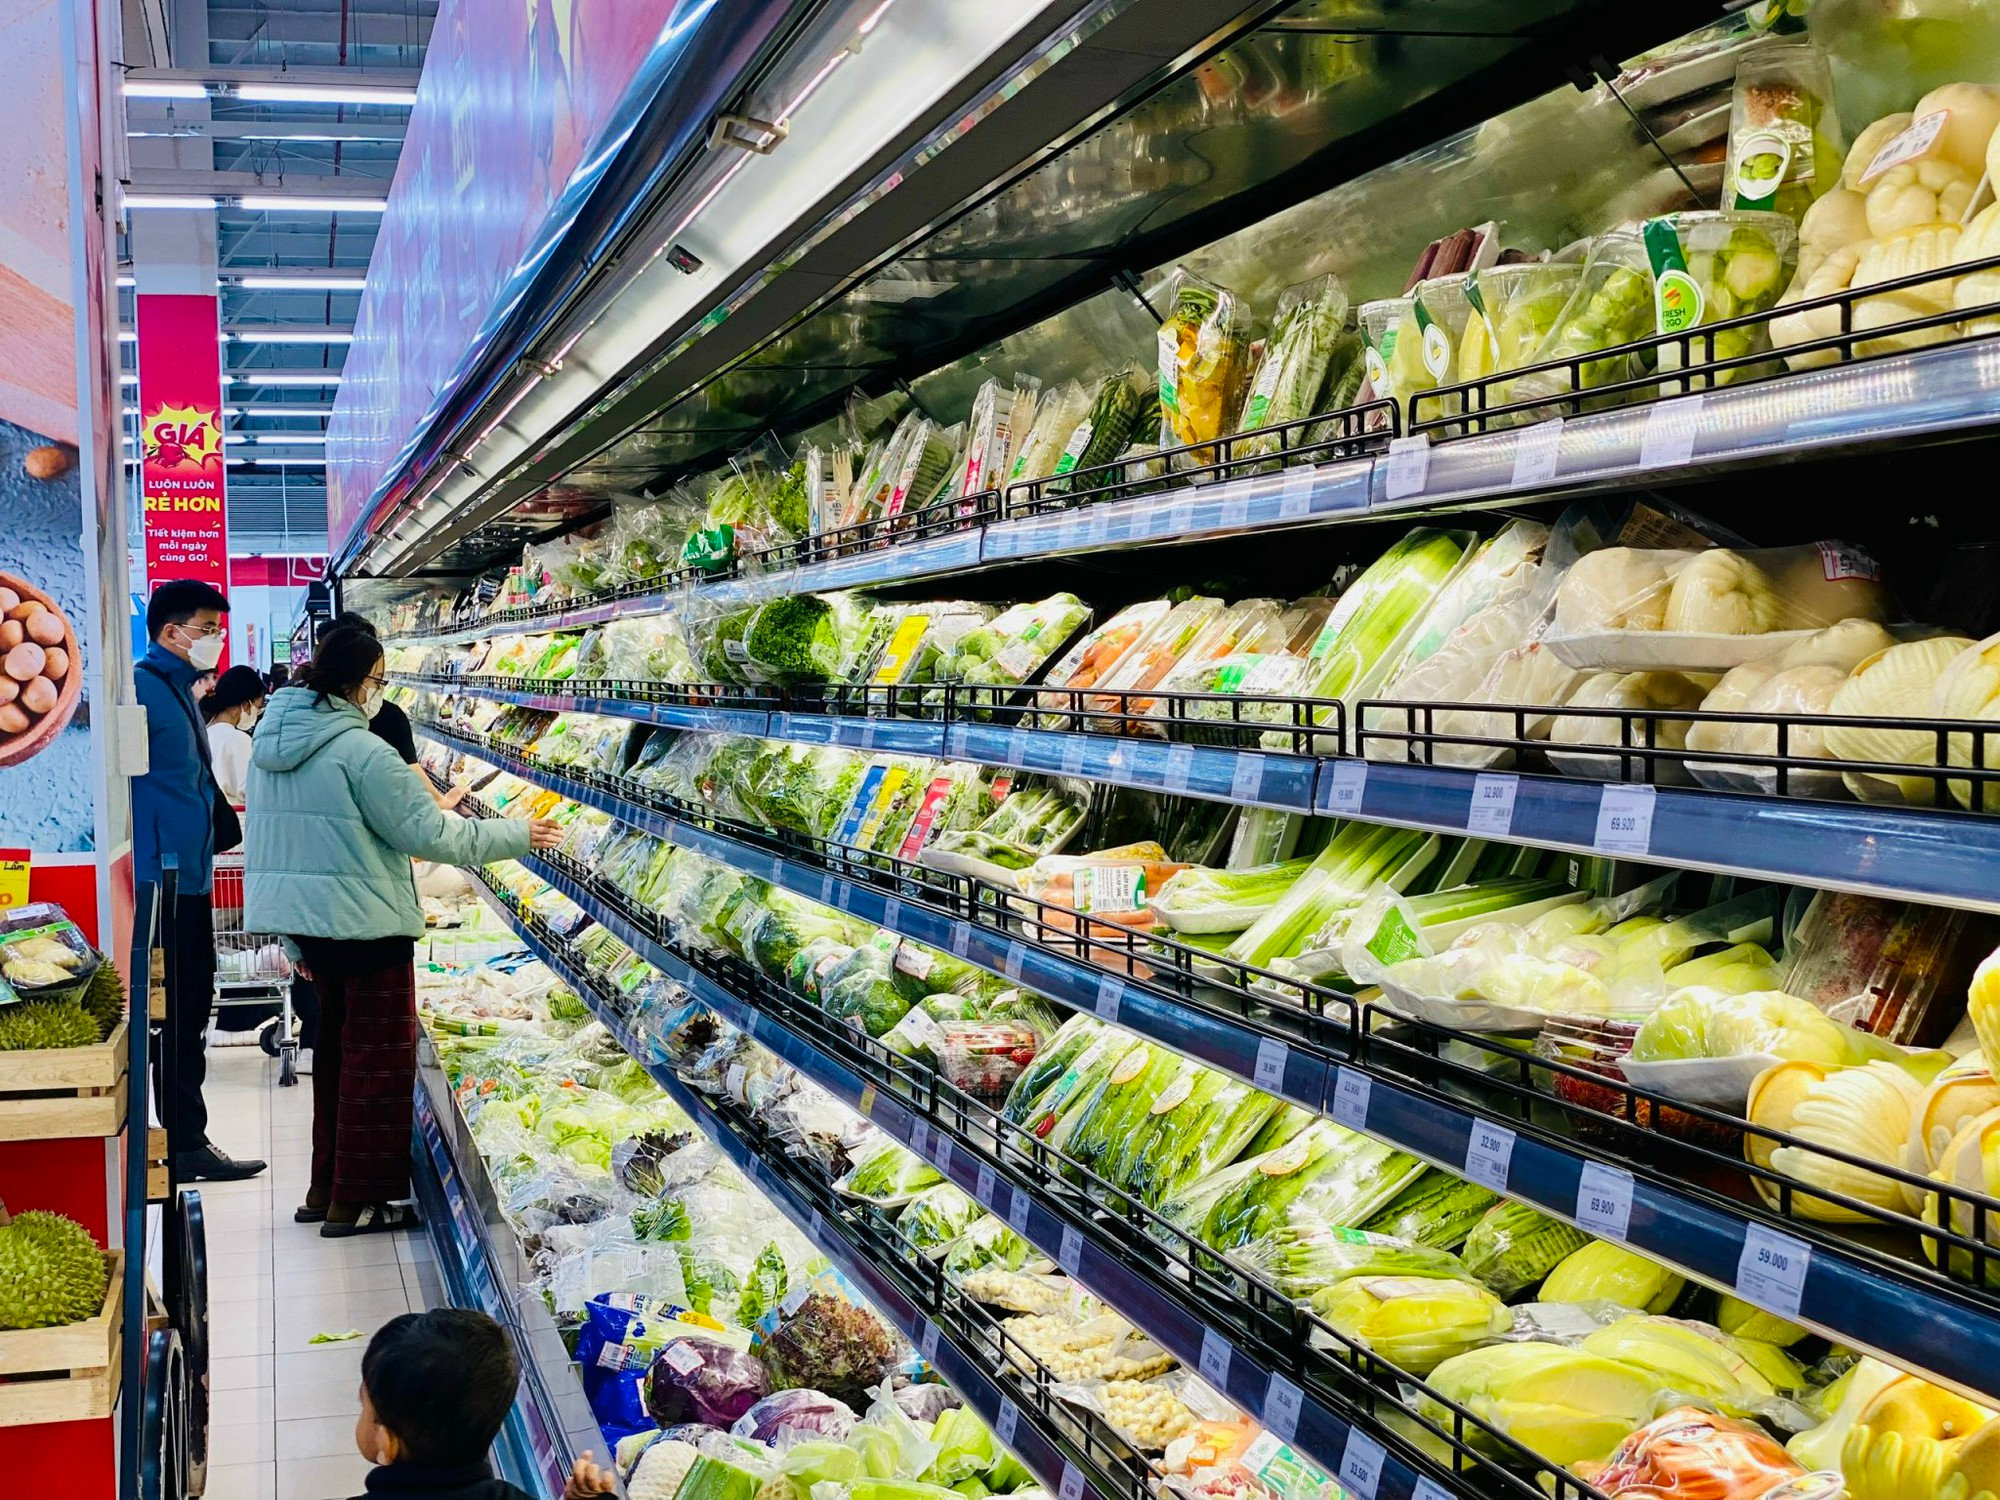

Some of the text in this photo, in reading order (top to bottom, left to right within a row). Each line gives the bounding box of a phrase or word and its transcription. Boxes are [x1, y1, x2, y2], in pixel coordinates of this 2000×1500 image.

[1662, 308, 1686, 318] FRESH
[1665, 318, 1682, 327] 2GO
[153, 421, 209, 451] GIÁ
[148, 478, 215, 489] LUÔN LUÔN
[144, 491, 220, 512] RẺ HƠN
[147, 528, 219, 539] Tiết kiệm hơn
[159, 540, 207, 551] mỗi ngày
[159, 552, 185, 563] cùng
[1610, 817, 1636, 831] 69.900
[1590, 1197, 1615, 1215] 69.900
[1758, 1248, 1788, 1271] 59.000
[1350, 1462, 1369, 1483] 33.500
